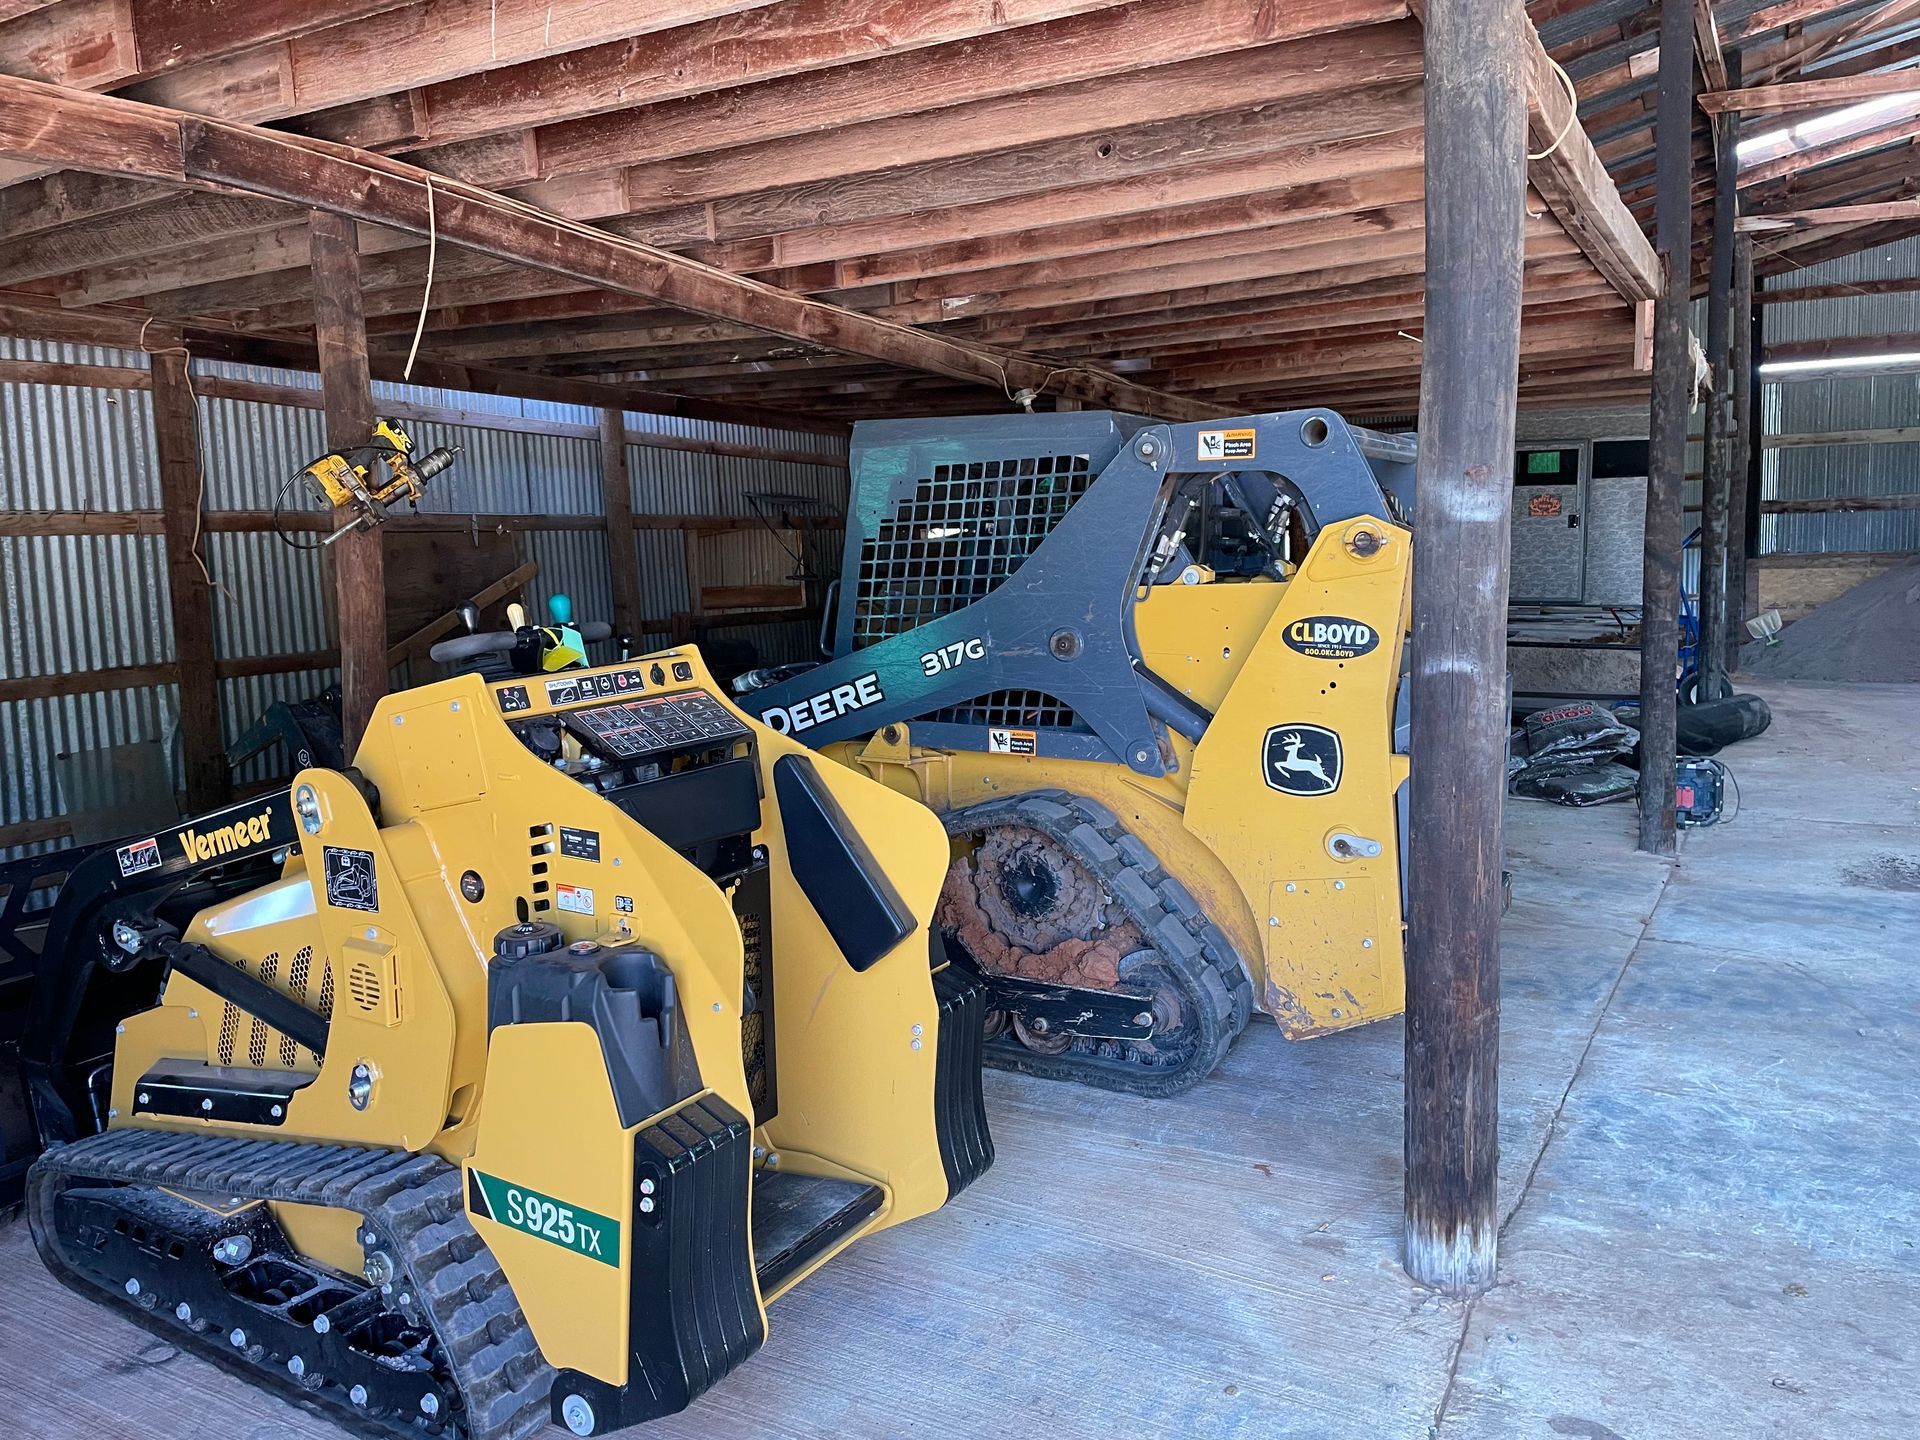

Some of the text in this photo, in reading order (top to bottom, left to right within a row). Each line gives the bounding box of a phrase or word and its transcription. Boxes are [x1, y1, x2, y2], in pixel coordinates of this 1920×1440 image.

[920, 638, 985, 676] 317G
[1304, 648, 1354, 657] 800.OKC.BOYD
[761, 673, 883, 735] DEERE
